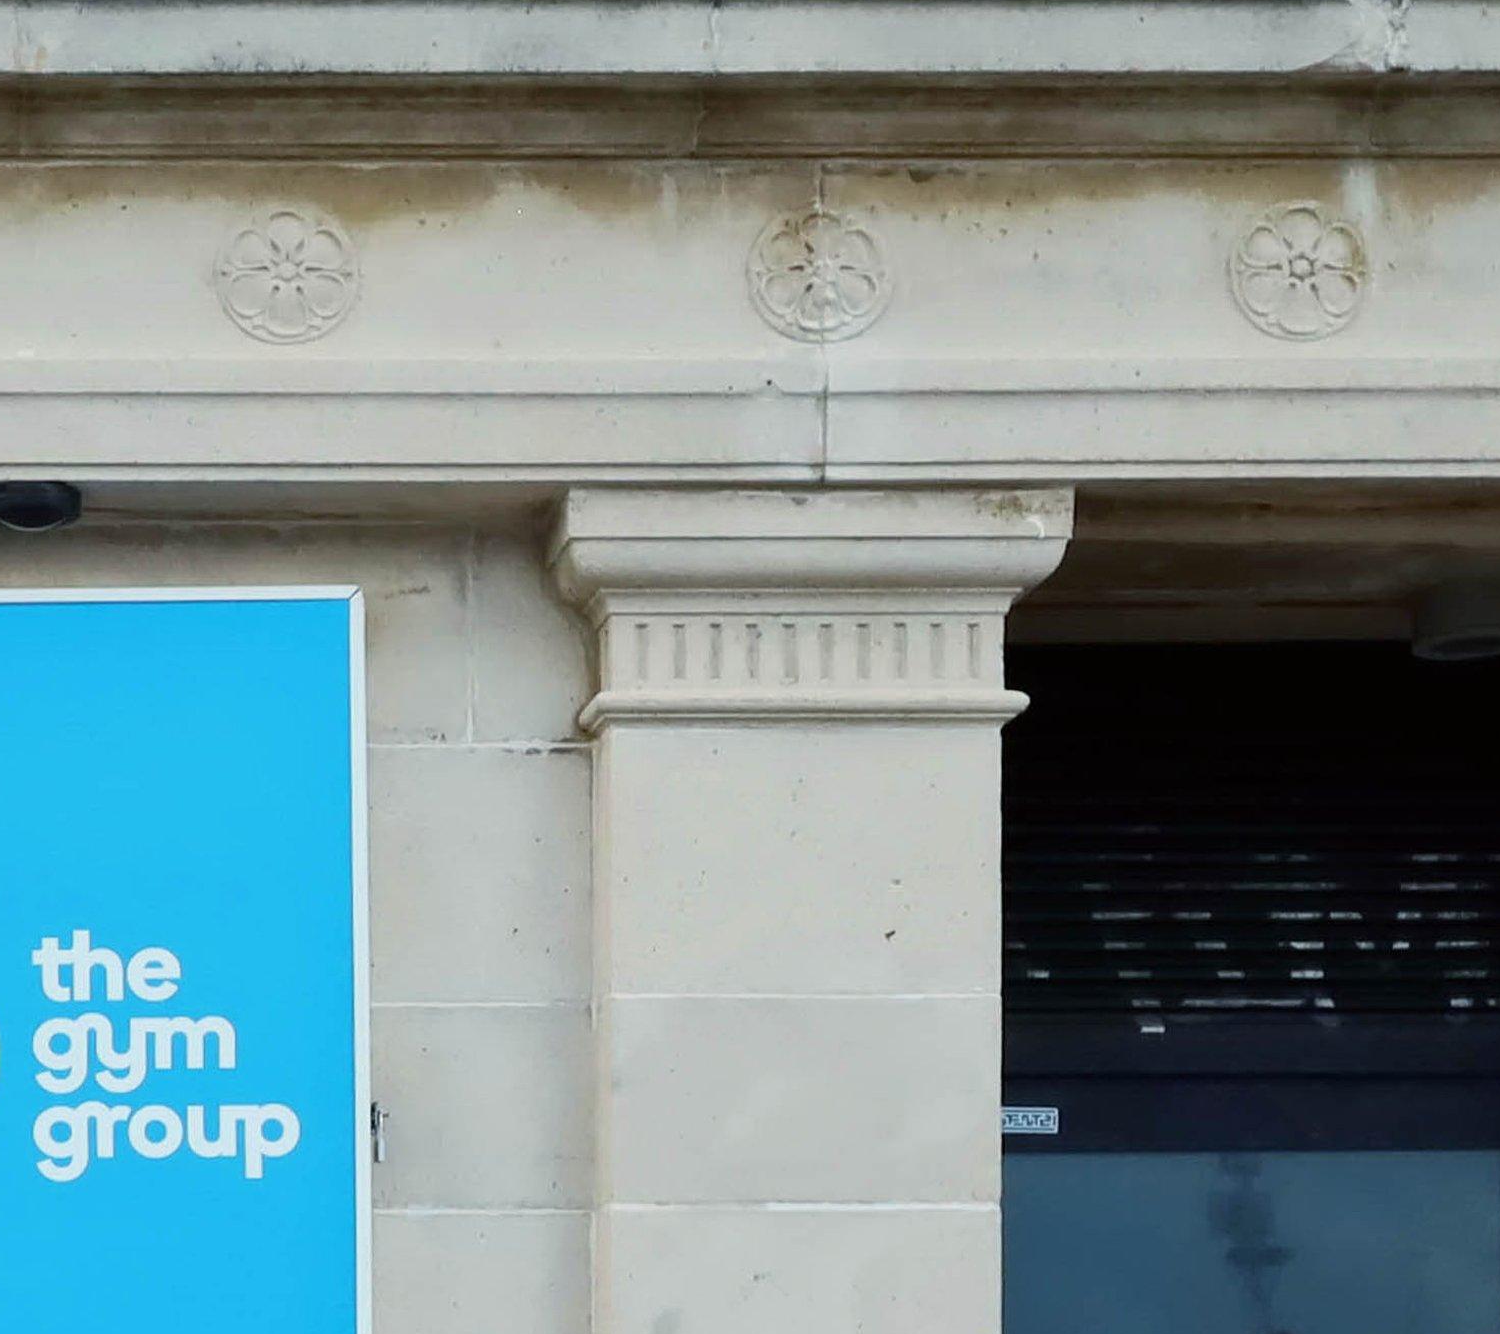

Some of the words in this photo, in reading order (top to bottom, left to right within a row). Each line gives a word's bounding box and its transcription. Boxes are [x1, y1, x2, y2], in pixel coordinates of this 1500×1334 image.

[30, 928, 183, 1002] the
[31, 1011, 237, 1094] gym
[32, 1099, 301, 1182] group
